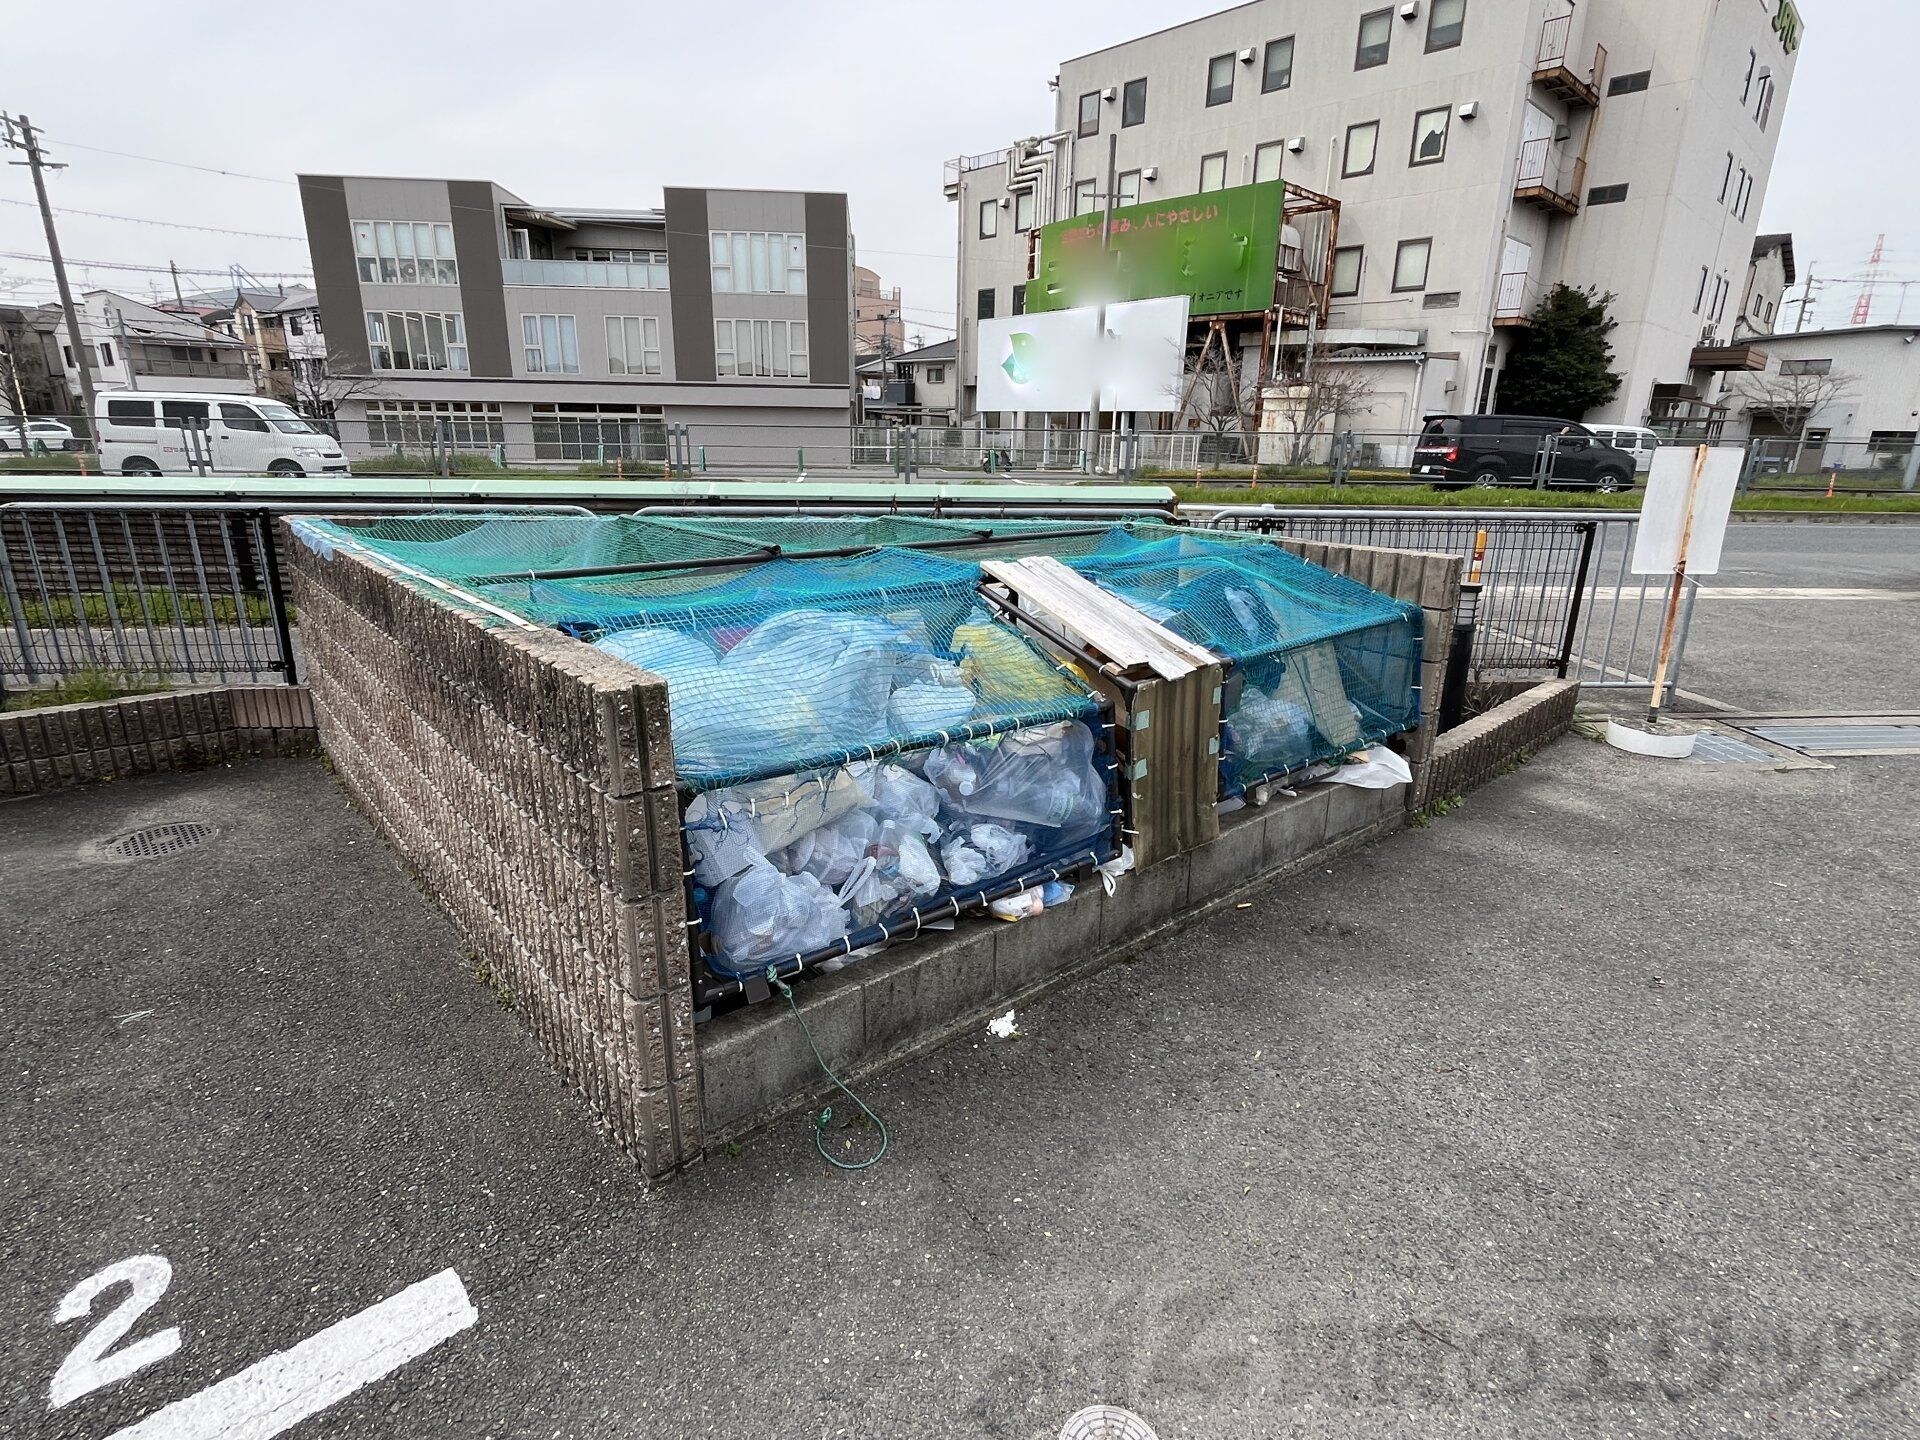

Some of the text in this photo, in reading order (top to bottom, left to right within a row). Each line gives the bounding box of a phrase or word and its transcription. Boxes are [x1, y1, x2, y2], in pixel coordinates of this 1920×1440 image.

[1189, 288, 1243, 303] イオニアです
[49, 1253, 183, 1409] 2
